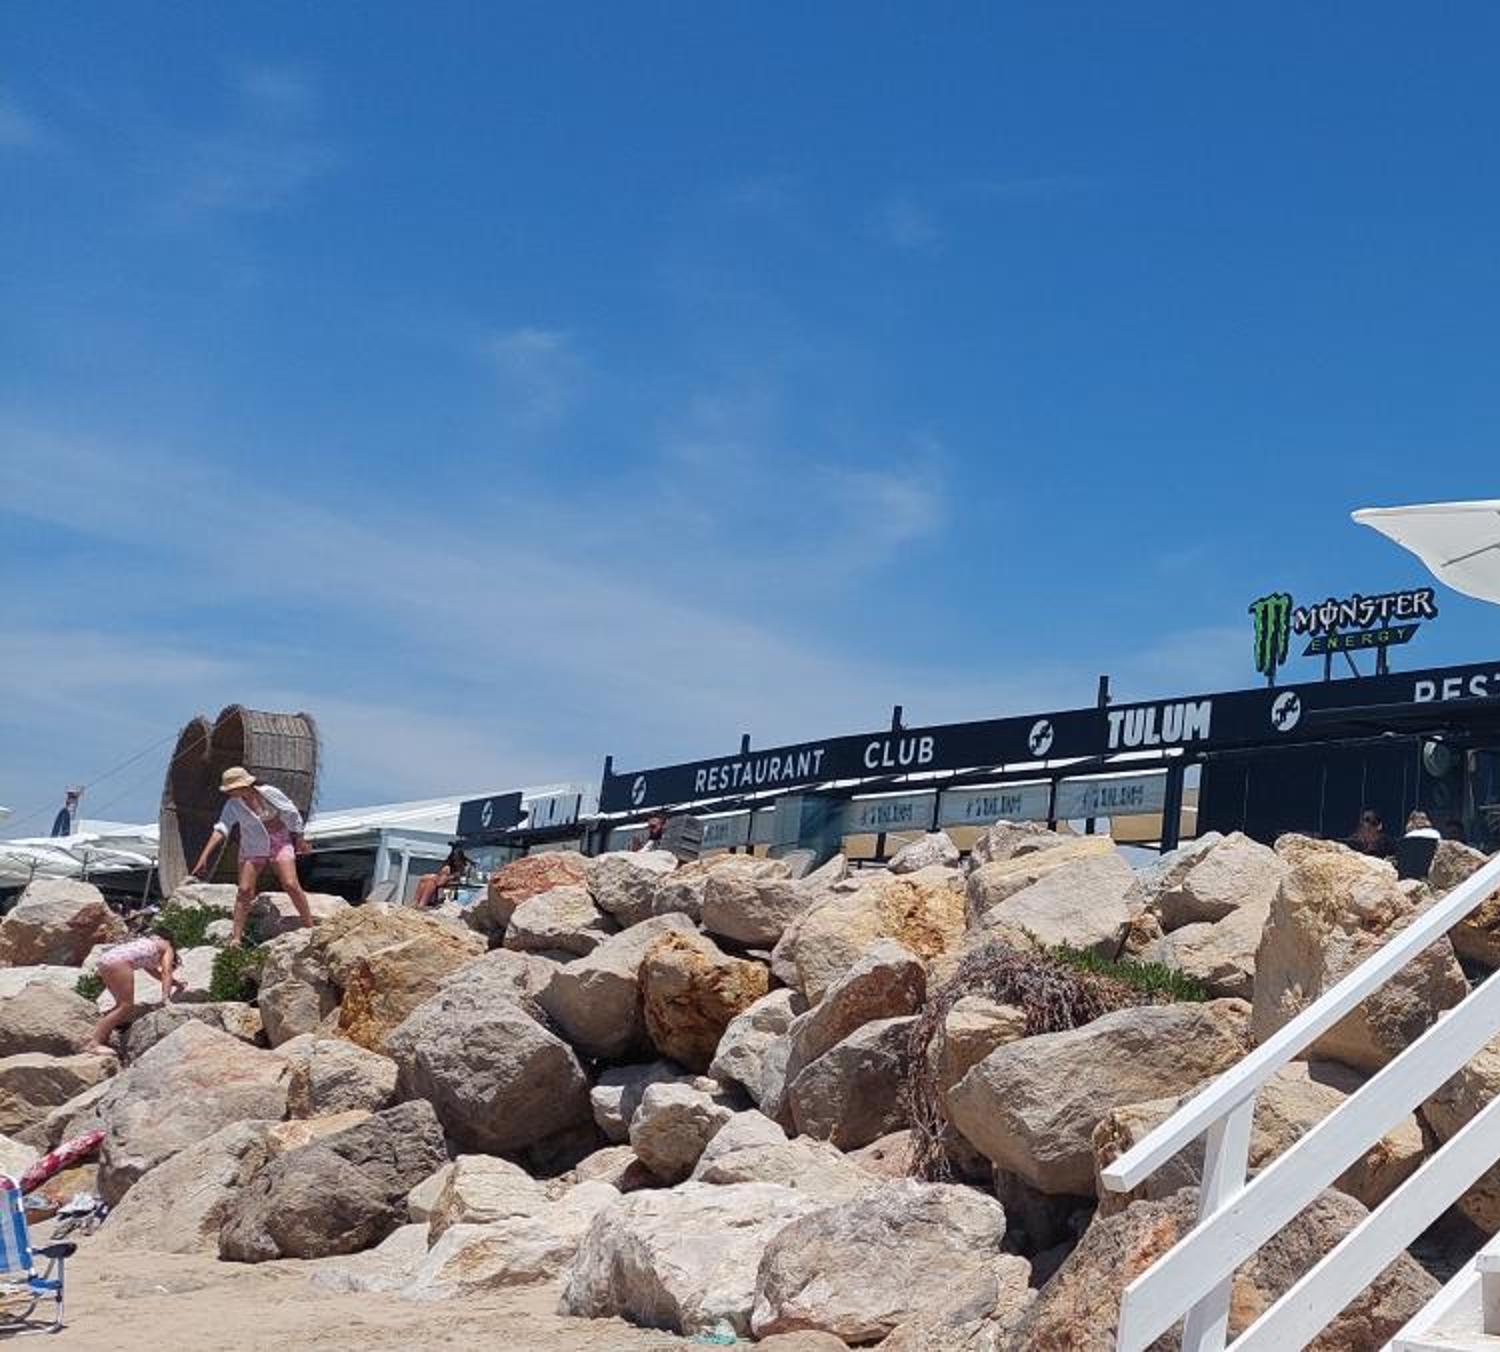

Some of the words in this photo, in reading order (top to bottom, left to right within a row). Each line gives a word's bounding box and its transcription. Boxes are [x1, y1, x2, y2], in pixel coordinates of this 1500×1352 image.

[1294, 589, 1434, 634] MONSTER
[1310, 628, 1406, 652] ENERGY
[1107, 700, 1213, 750] TULUM
[694, 749, 825, 793] RESTAURANT
[863, 736, 935, 769] CLUB
